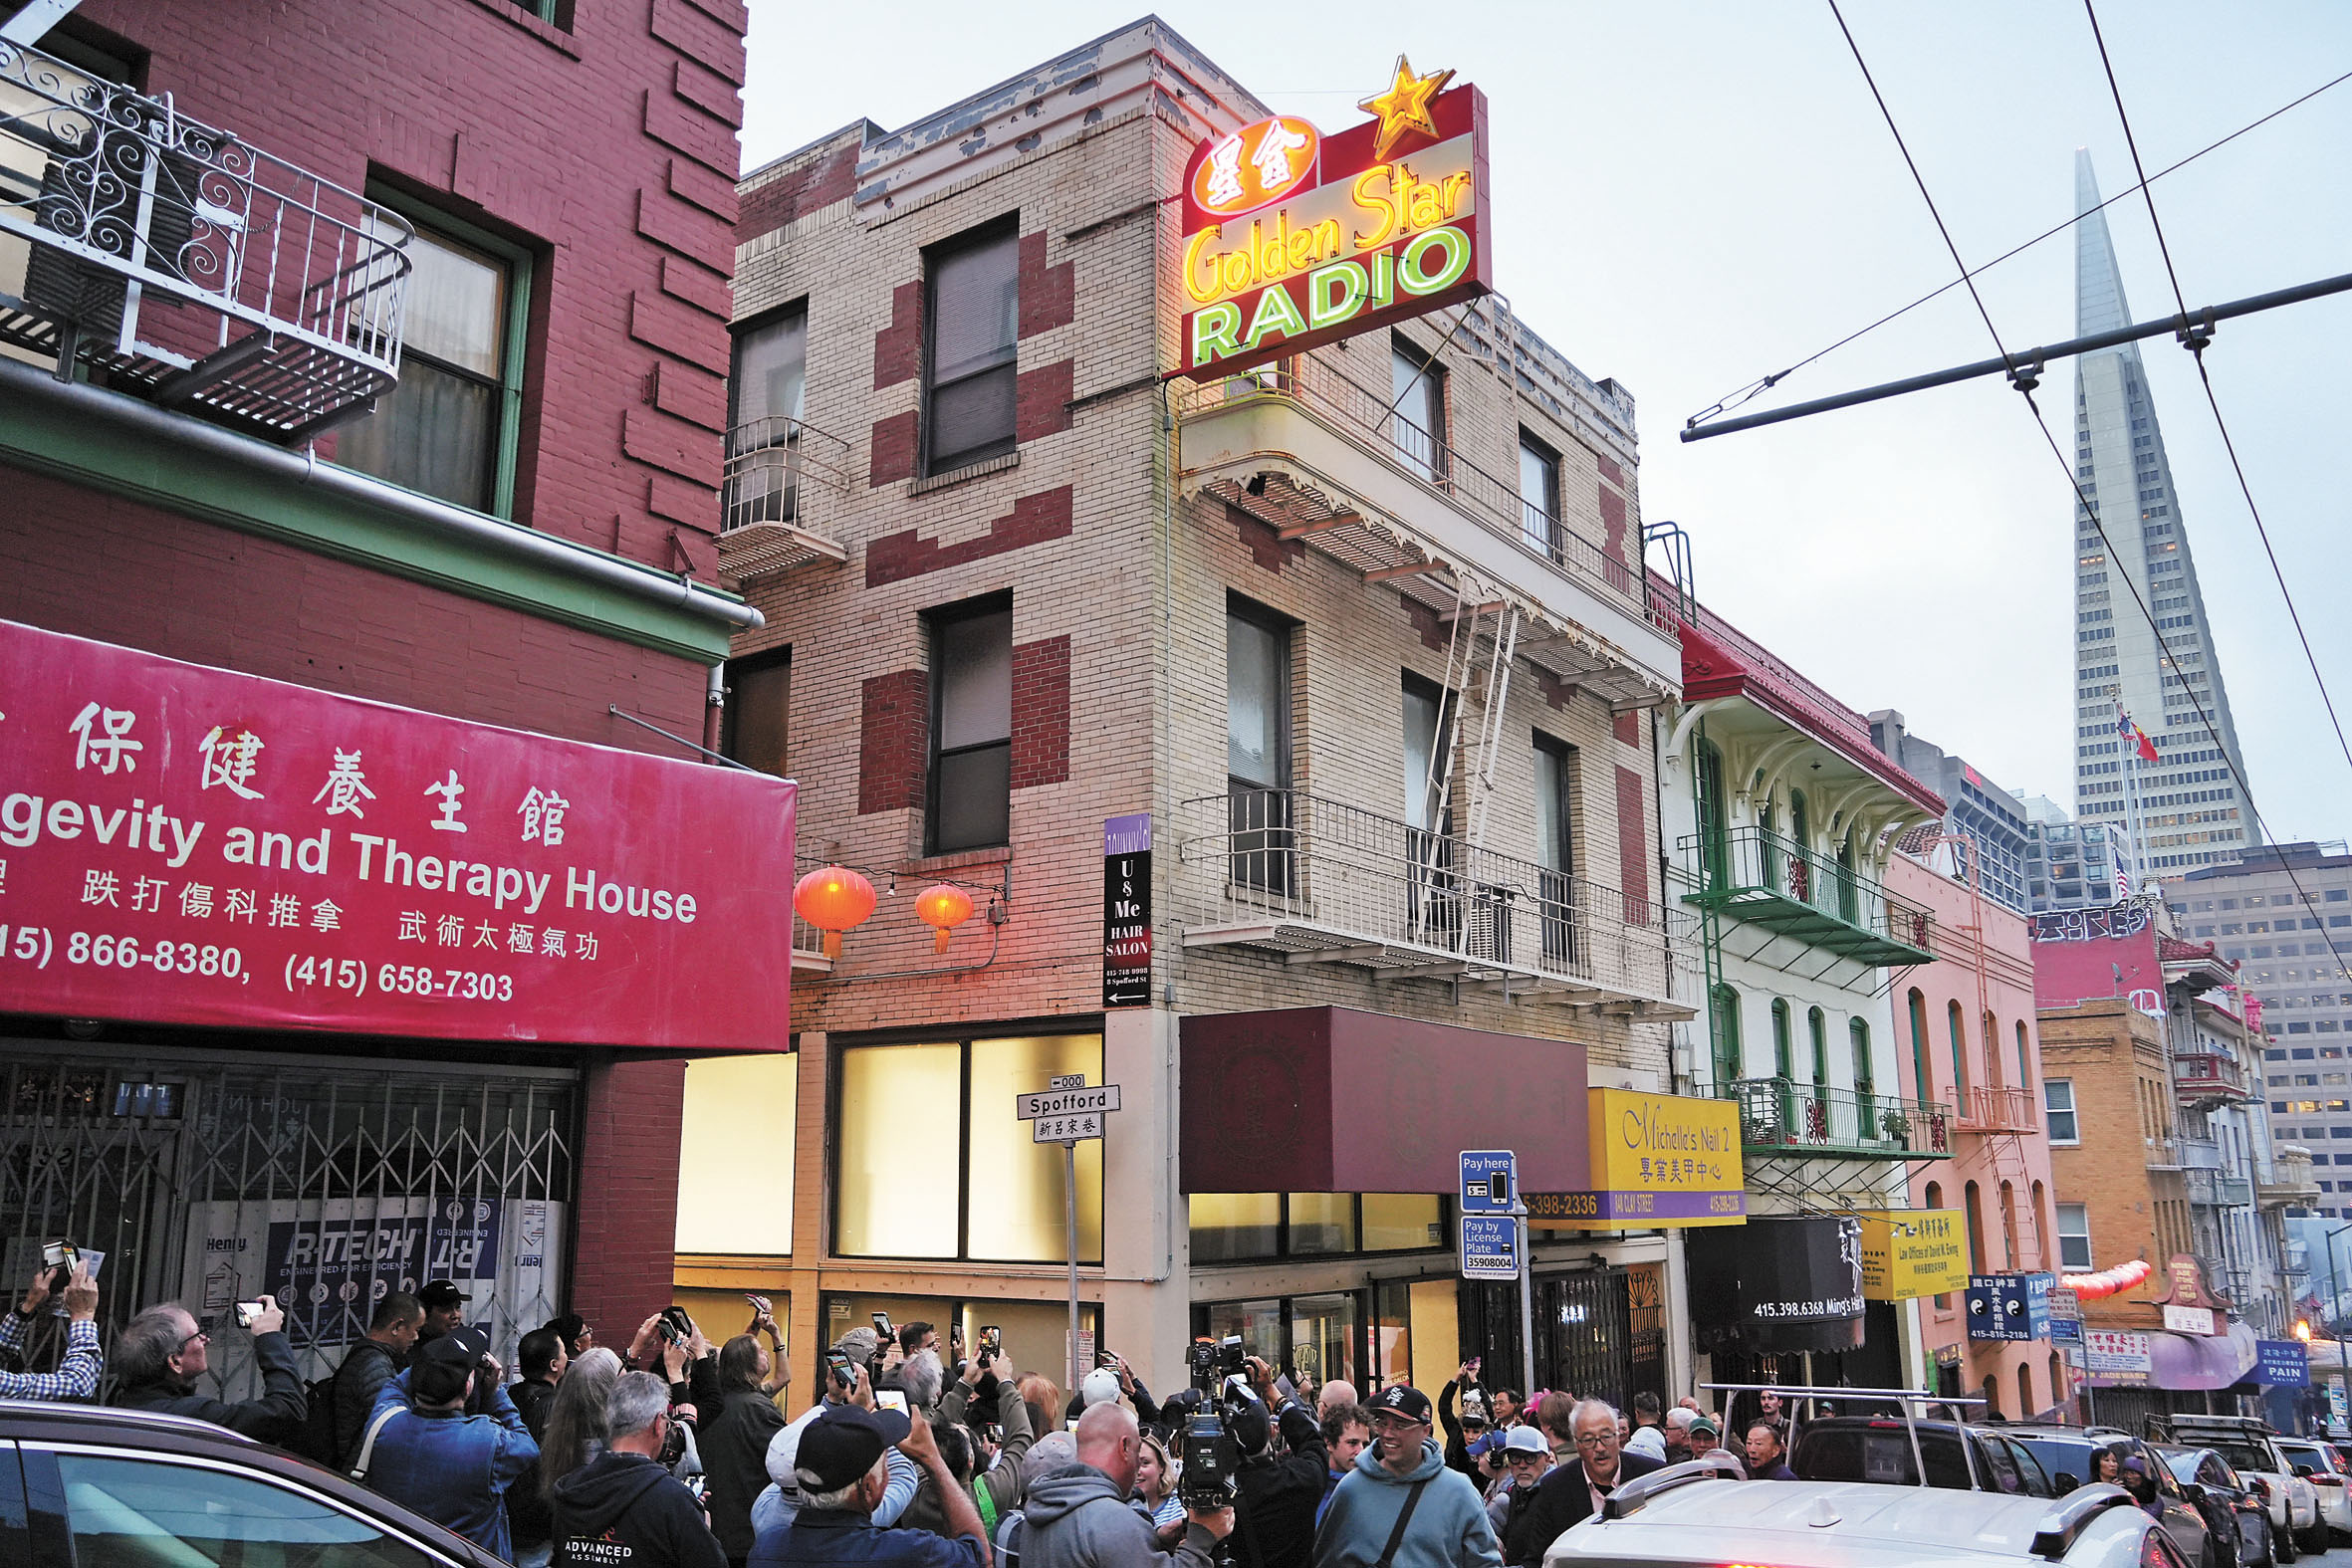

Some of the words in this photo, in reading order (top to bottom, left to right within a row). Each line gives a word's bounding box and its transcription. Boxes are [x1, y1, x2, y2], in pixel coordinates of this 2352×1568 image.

[1183, 208, 1340, 303] Golden
[1352, 162, 1472, 248] Star
[1192, 225, 1472, 368] RADIO
[0, 792, 205, 868] gevity
[223, 826, 332, 874] and
[351, 832, 552, 914] Therapy
[566, 866, 697, 924] House
[1120, 860, 1133, 878] U
[1122, 881, 1132, 897] &
[81, 869, 344, 932] 跌打傷科推拿
[397, 910, 598, 961] 武術太極氣功
[1115, 901, 1140, 919] Me
[1111, 925, 1143, 940] HAIR
[1105, 941, 1148, 957] SALON
[67, 931, 250, 985] 866-8380,
[285, 954, 367, 998] (415)
[378, 964, 513, 1002] 658-7303
[1112, 976, 1139, 986] Spofford
[1030, 1091, 1106, 1115] Spofford
[1039, 1117, 1096, 1136] 新呂宋巷
[1623, 1101, 1697, 1152] Michelle's
[1701, 1125, 1720, 1152] Nail
[1723, 1126, 1730, 1152] 2
[1464, 1158, 1483, 1171] Pay
[1484, 1157, 1510, 1169] here
[1639, 1157, 1722, 1183] 專業美甲中心
[1465, 1221, 1483, 1232] Pay
[1486, 1221, 1499, 1233] by
[1466, 1232, 1503, 1242] License
[285, 1228, 417, 1264] R-TECH
[1466, 1242, 1492, 1253] Plate
[1468, 1257, 1512, 1267] 35908004
[279, 1265, 339, 1277] ENGINERED
[1754, 1301, 1824, 1317] 415.398.6368
[1826, 1297, 1851, 1316] Ming's
[1972, 1330, 2029, 1339] 415-816-2184
[2268, 1367, 2300, 1378] PAIN
[565, 1541, 632, 1557] ADVANCED
[571, 1553, 620, 1565] ASSEMBLY
